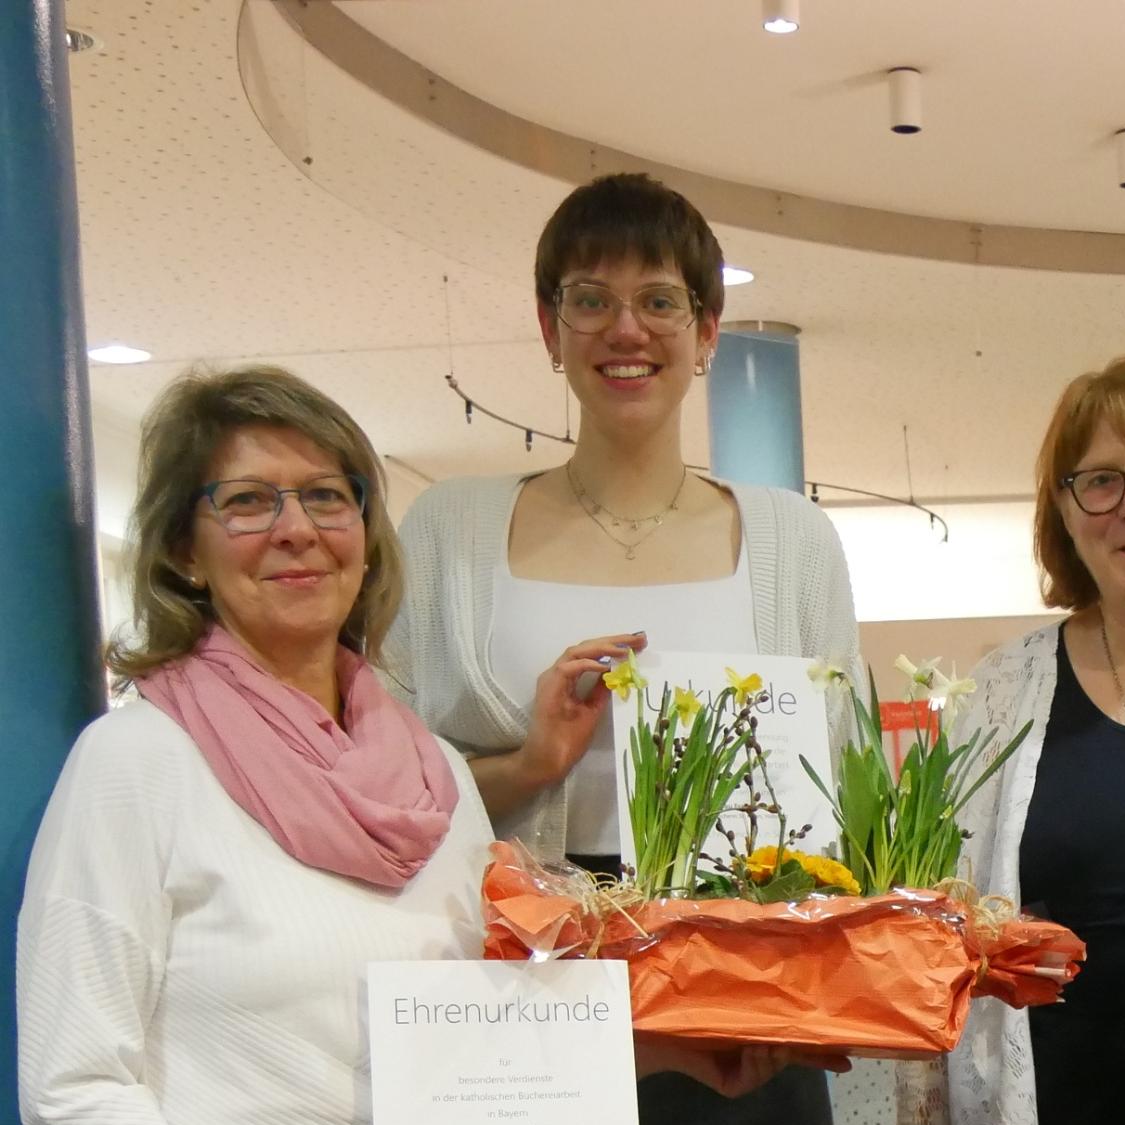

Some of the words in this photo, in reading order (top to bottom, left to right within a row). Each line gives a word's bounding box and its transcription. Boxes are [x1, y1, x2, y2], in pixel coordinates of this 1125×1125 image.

[394, 995, 610, 1025] Ehrenurkunde
[458, 1075, 505, 1085] besondere
[508, 1074, 553, 1084] Verdienste
[443, 1093, 457, 1102] der
[460, 1091, 516, 1102] katholischen
[498, 1109, 529, 1120] Bayern
